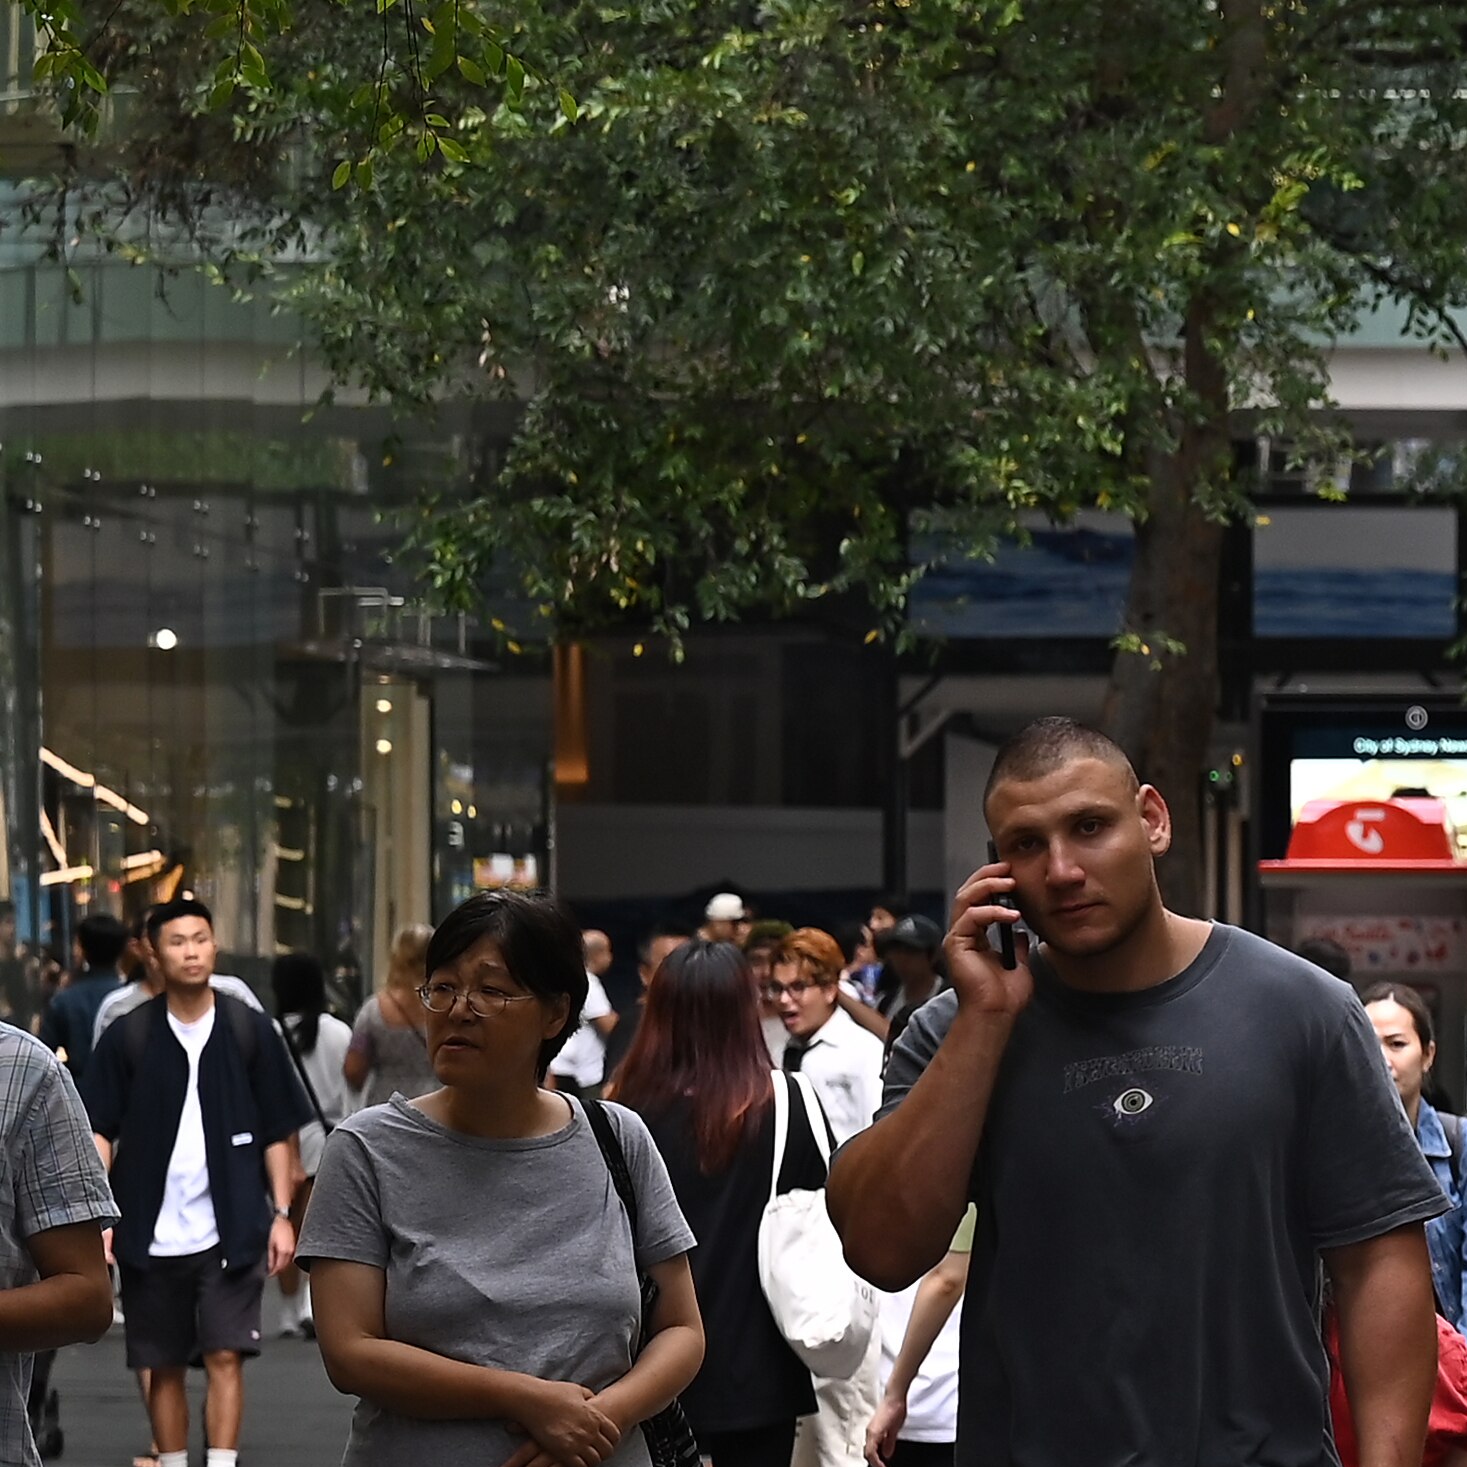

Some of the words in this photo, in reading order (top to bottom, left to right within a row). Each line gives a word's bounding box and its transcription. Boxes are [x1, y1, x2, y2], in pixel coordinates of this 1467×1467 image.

[1353, 737, 1379, 756] City
[1379, 737, 1394, 754] of
[1394, 737, 1439, 756] Sydney
